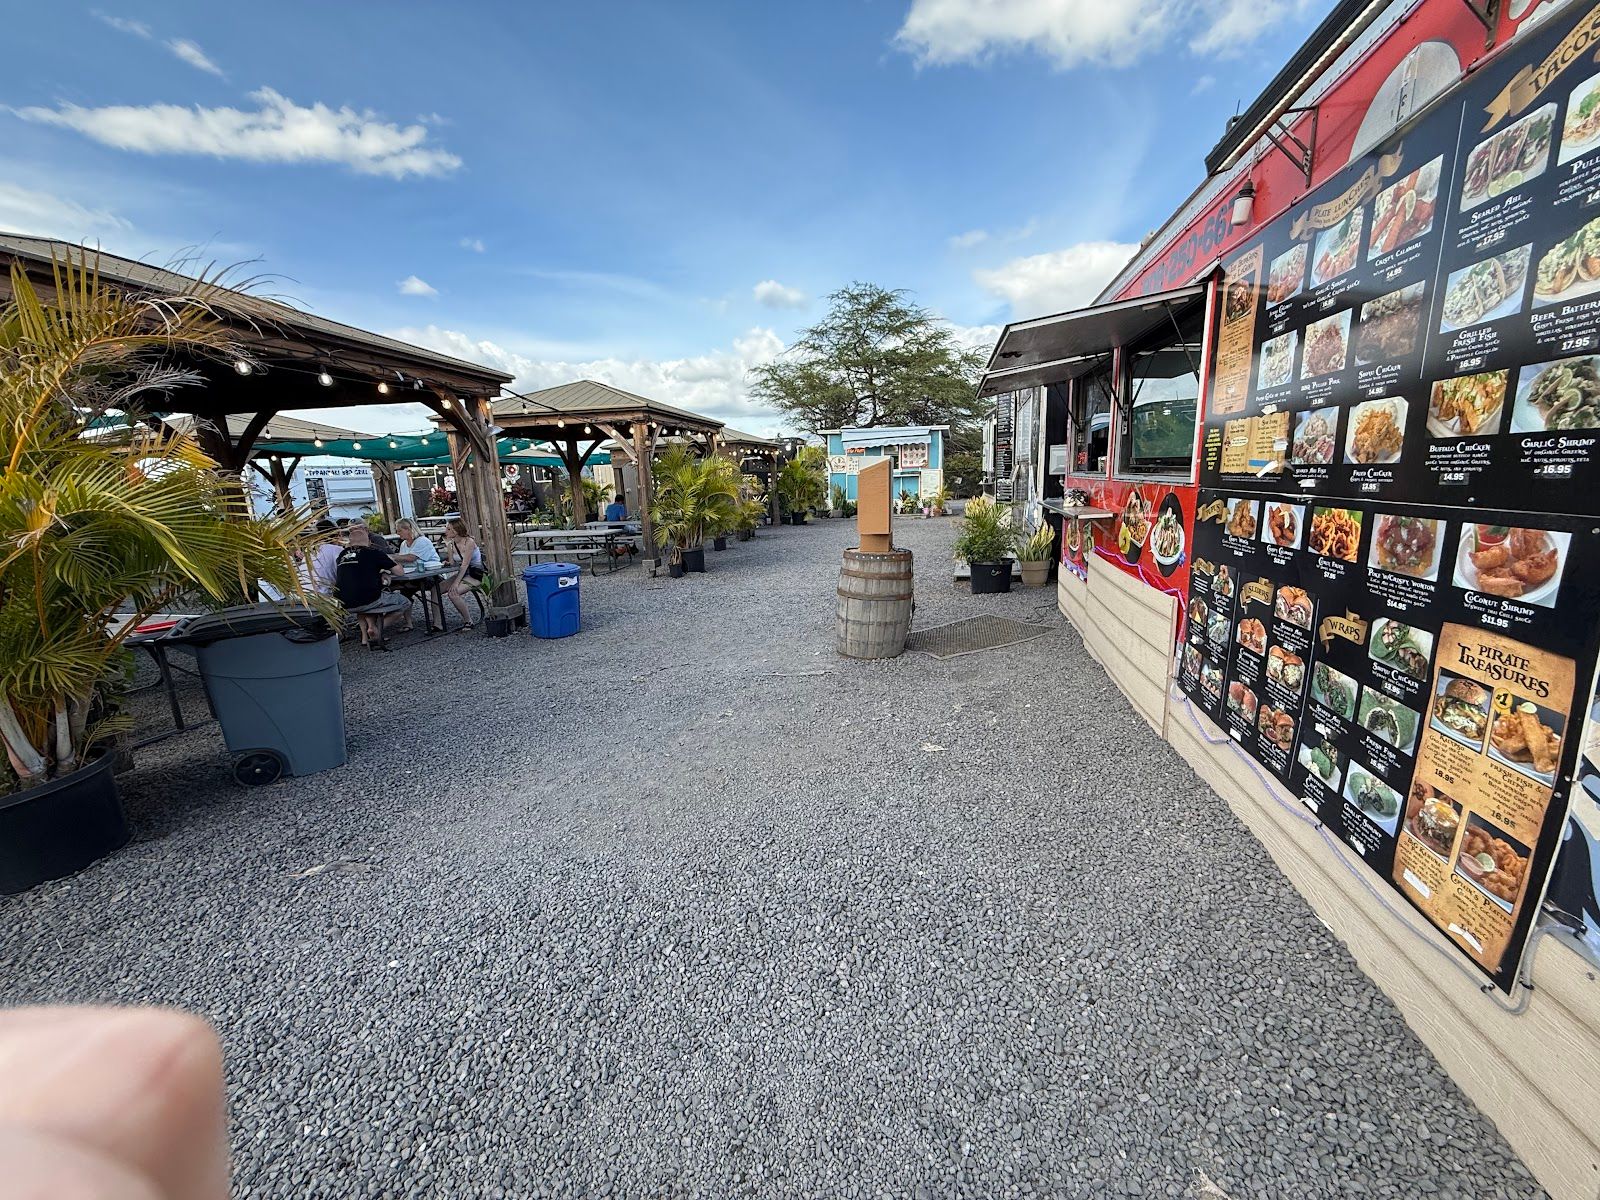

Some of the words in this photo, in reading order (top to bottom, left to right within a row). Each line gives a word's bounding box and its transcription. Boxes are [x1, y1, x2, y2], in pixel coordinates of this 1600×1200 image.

[1471, 204, 1501, 224] SEARED
[1530, 312, 1557, 324] BEER
[1561, 300, 1600, 316] BATTER
[1452, 337, 1476, 348] FRESH
[1478, 331, 1498, 342] FISH
[1458, 326, 1492, 340] GRILLED
[1561, 336, 1590, 351] 17.95
[1375, 364, 1401, 376] CHICKEN
[1429, 444, 1455, 453] BUFFALO
[1456, 441, 1491, 454] CHICKEN
[1521, 438, 1555, 448] GARLIC
[1557, 436, 1596, 449] SHRIMP
[1366, 467, 1393, 478] CHICKEN
[1443, 472, 1465, 481] 14.95
[1542, 464, 1572, 474] 16.95
[1367, 567, 1381, 576] POKE
[1248, 585, 1269, 601] SLIDERS
[1386, 599, 1407, 611] $14.95
[1464, 591, 1499, 608] COCONUT
[1500, 600, 1535, 616] SHRIMP
[1481, 613, 1509, 628] $11.95
[1329, 621, 1360, 641] WRAPS
[1477, 643, 1530, 672] PIRATE
[1457, 642, 1549, 698] TREASURES
[1391, 670, 1419, 689] CHICKEN
[1496, 693, 1509, 706] #1
[1490, 762, 1512, 778] FRESH
[1516, 776, 1533, 789] FISH
[1535, 785, 1544, 794] &
[1502, 774, 1525, 792] CHIPS
[1451, 873, 1479, 901] CAPTAIN'S
[1482, 895, 1513, 928] PLATTER
